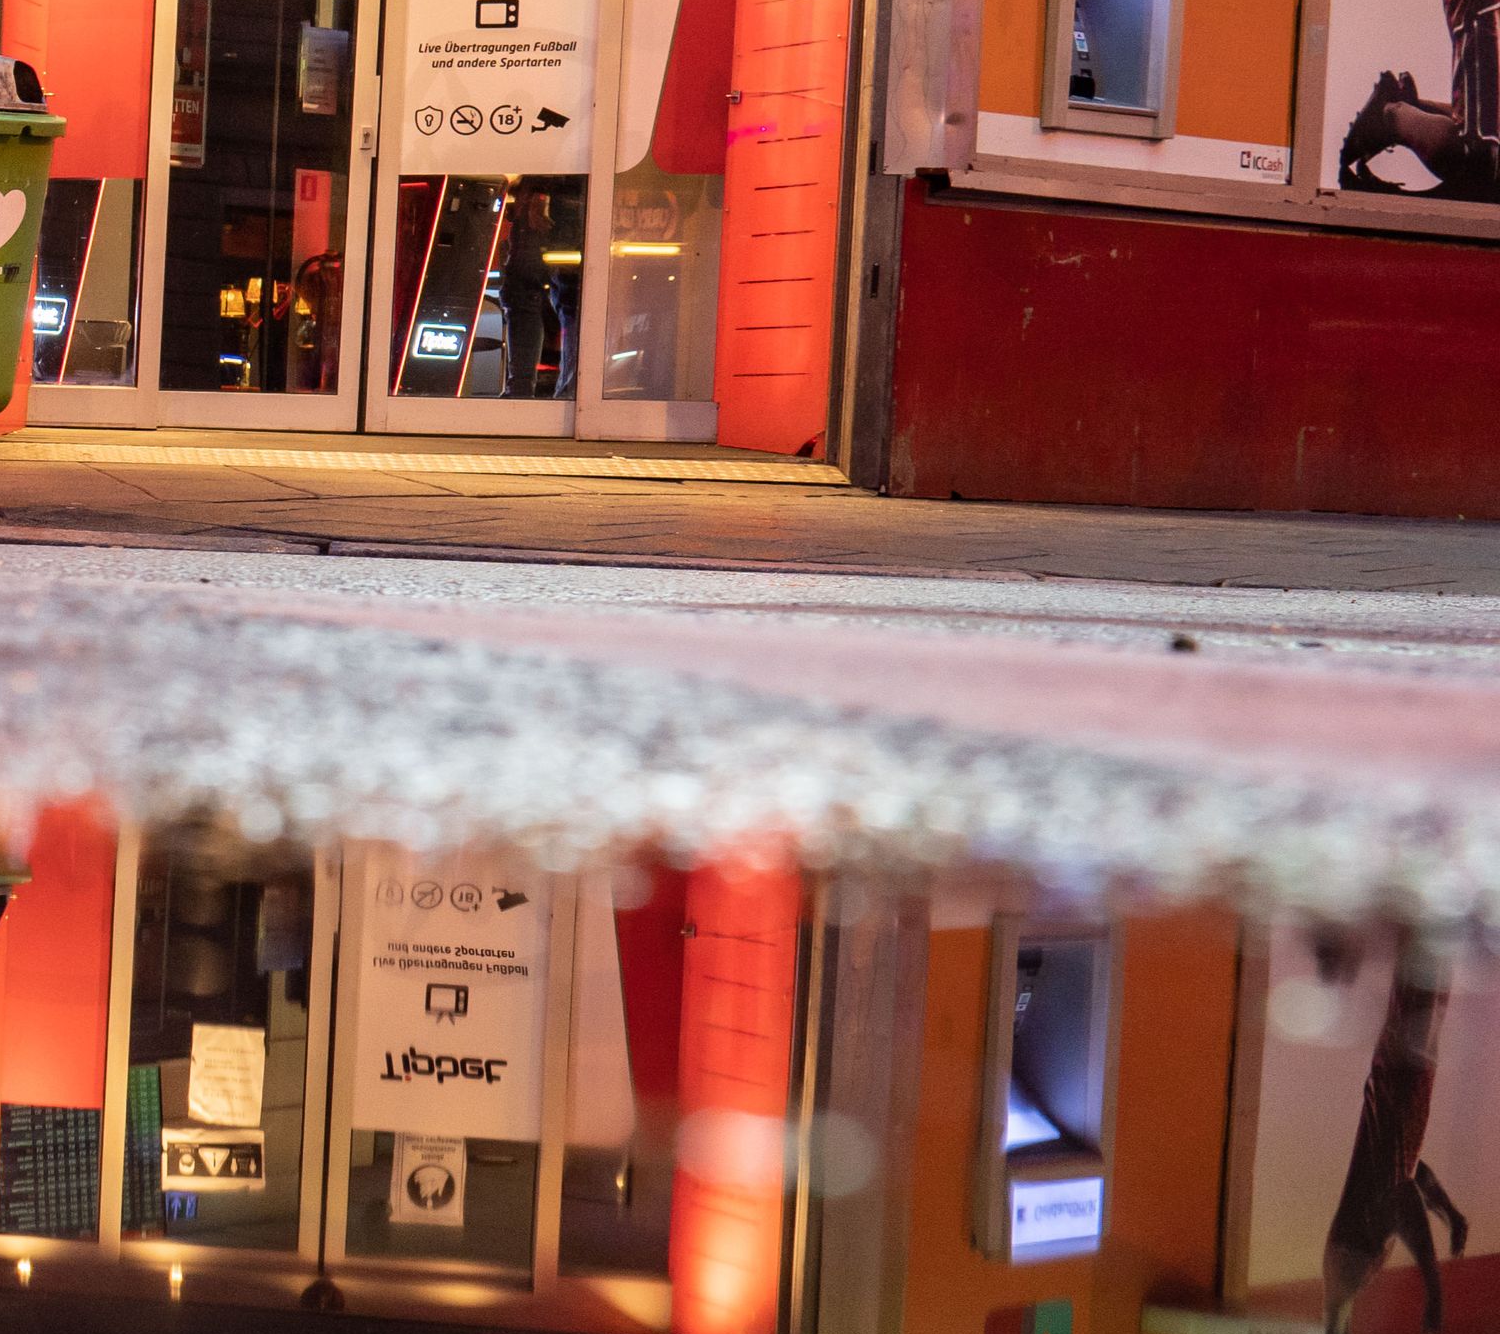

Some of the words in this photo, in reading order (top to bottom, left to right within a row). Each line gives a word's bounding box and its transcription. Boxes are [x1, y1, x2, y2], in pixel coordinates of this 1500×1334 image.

[418, 43, 442, 54] Live
[444, 40, 530, 55] Übertragungen
[533, 40, 577, 52] Fußball
[431, 58, 453, 69] und
[456, 57, 497, 68] andere
[499, 57, 562, 70] Sportarten
